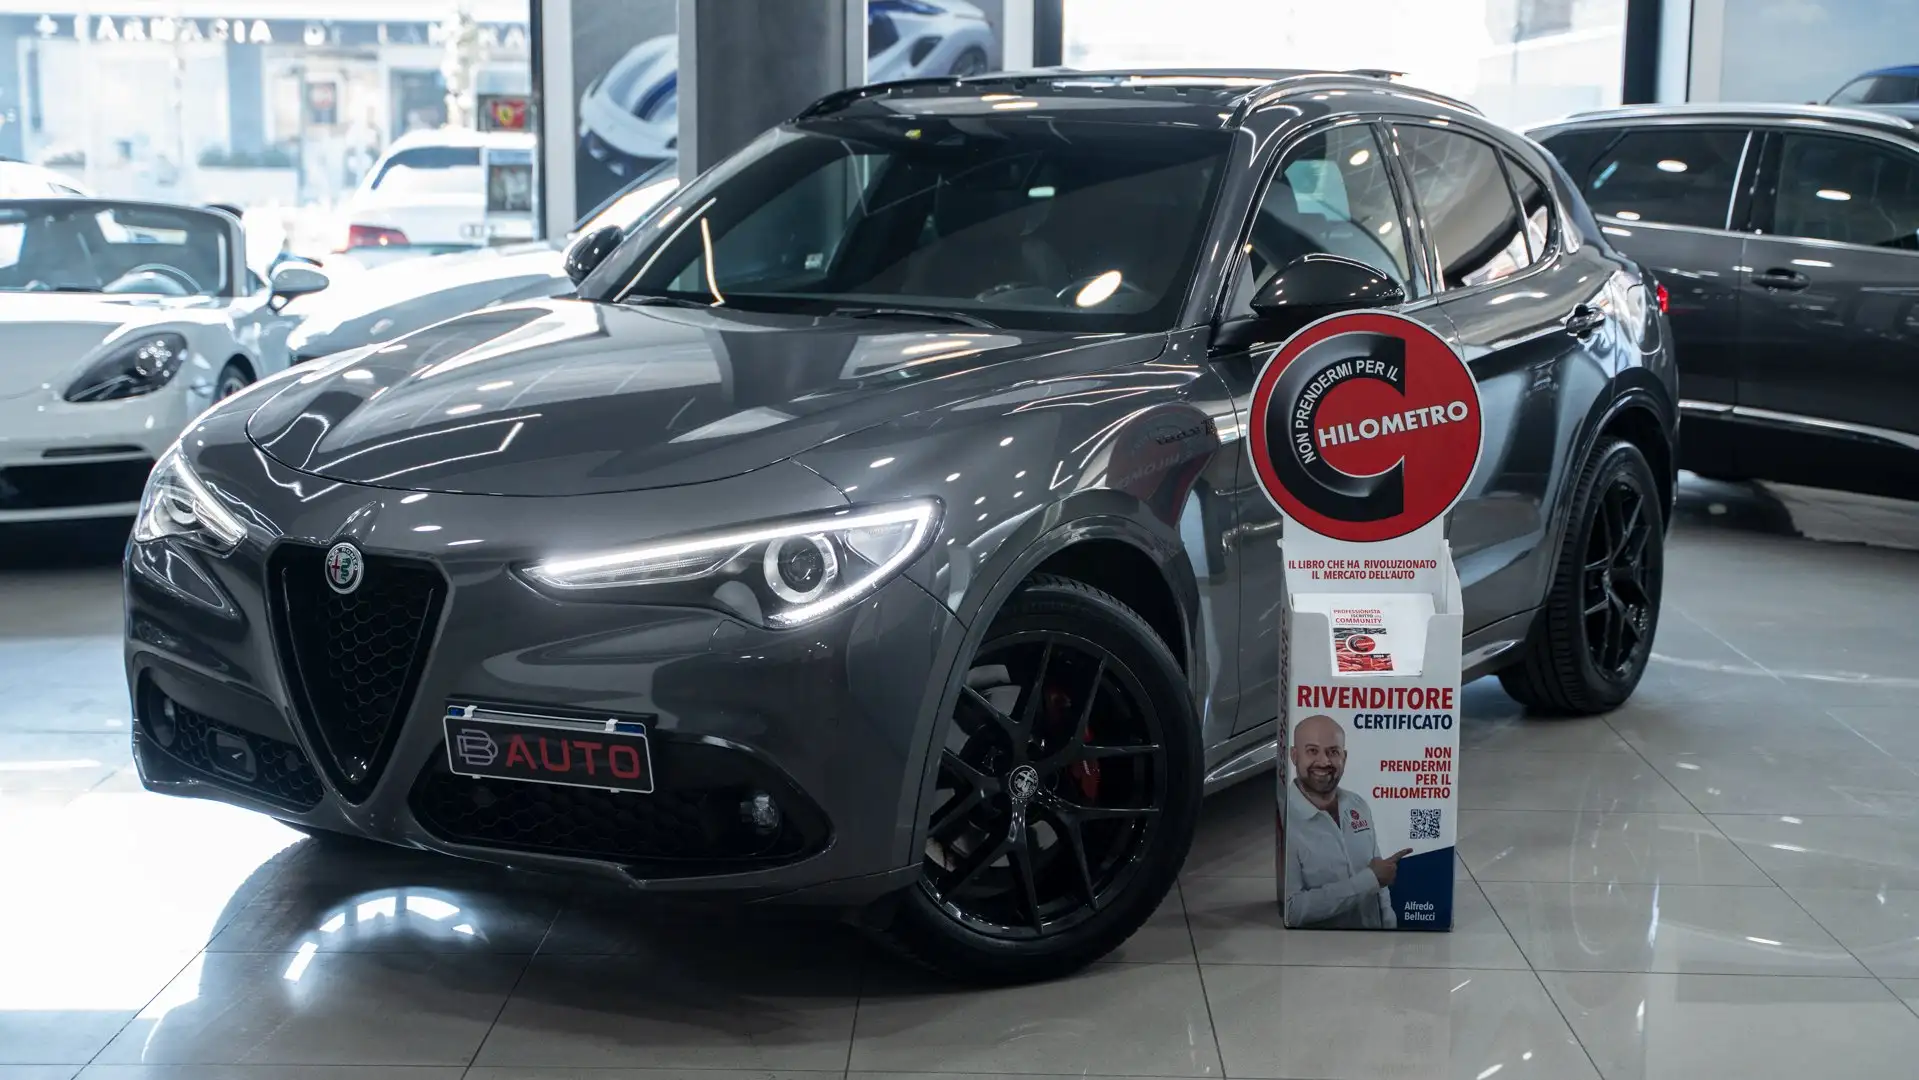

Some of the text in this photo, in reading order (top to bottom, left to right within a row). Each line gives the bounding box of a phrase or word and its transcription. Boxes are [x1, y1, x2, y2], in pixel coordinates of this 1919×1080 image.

[1295, 360, 1399, 464] NON PRENDERMI PER IL
[1318, 400, 1468, 448] HILOMETRO
[1288, 560, 1437, 569] IL LIBRO CHE HA RIVOLUZIONATO
[1312, 571, 1415, 580] IL MERCATO DELL'AUTO
[1297, 685, 1454, 710] RIVENDITORE
[1353, 714, 1453, 730] CERTIFICATO
[505, 733, 641, 779] AUTO
[1424, 747, 1452, 759] NON
[1380, 760, 1451, 772] PRENDERMI
[1415, 774, 1452, 785] PER IL
[1372, 787, 1451, 799] CHILOMETRO
[1404, 901, 1434, 911] Alfredo
[1404, 912, 1436, 921] Bellucci
